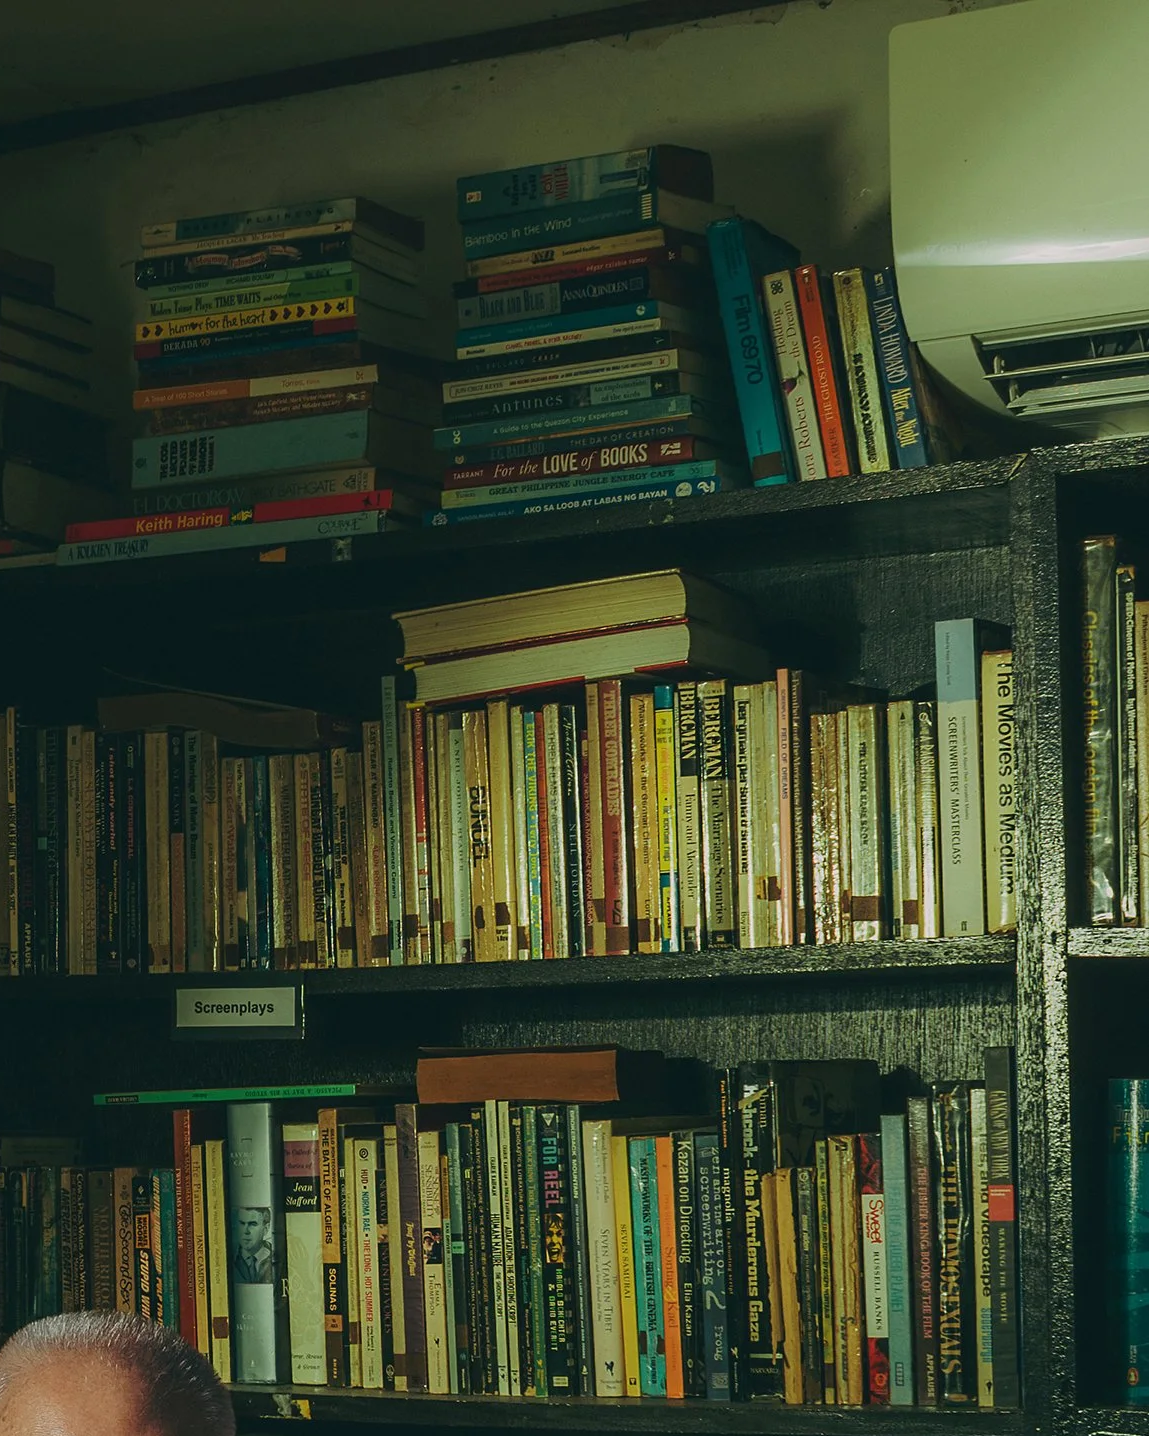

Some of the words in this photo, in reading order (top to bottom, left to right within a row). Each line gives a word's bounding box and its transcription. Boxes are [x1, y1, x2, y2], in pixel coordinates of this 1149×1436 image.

[465, 231, 507, 248] Bamboo
[544, 217, 571, 232] Wind
[206, 319, 220, 330] for
[222, 314, 237, 328] the
[240, 313, 265, 326] heart
[732, 294, 751, 333] Film
[785, 301, 797, 338] Dream
[874, 295, 899, 335] LINDA
[163, 341, 198, 352] DEKADA
[200, 338, 211, 347] 90
[771, 309, 787, 355] Holding
[812, 335, 824, 366] ROAD
[881, 331, 908, 384] HOWARD
[820, 367, 833, 402] GHOST
[891, 387, 913, 412] After
[500, 424, 519, 432] Guide
[531, 421, 543, 429] the
[545, 417, 570, 427] Quezon
[572, 415, 586, 424] City
[588, 408, 628, 422] Experience
[795, 396, 813, 451] Roberts
[895, 419, 918, 448] Night
[453, 470, 484, 480] TARRANT
[494, 464, 514, 478] For
[519, 461, 538, 476] the
[543, 453, 577, 474] LOVE
[581, 450, 597, 470] of
[600, 443, 648, 466] BOOKS
[489, 486, 519, 496] GREAT
[522, 480, 570, 492] PHILIPPINE
[572, 477, 608, 487] JUNGLE
[611, 473, 648, 484] ENERGY
[524, 504, 541, 514] AKO
[543, 503, 555, 512] SA
[556, 500, 581, 510] LOOB
[582, 498, 592, 507] AT
[594, 494, 622, 506] LABAS
[624, 493, 637, 502] NG
[638, 489, 668, 501] BAYAN
[136, 517, 174, 534] Keith
[177, 512, 223, 529] Haring
[680, 690, 696, 760] BERGMAN
[704, 697, 722, 779] BERGMAN
[997, 704, 1015, 777] Movies
[682, 793, 695, 823] Fanny
[711, 784, 724, 808] The
[999, 782, 1013, 807] as
[569, 823, 578, 855] NEIL
[685, 823, 696, 845] and
[708, 812, 724, 864] Marriage
[950, 799, 961, 865] MASTERCLASS
[998, 815, 1015, 894] Medium
[571, 862, 581, 918] JORDAN
[685, 847, 696, 900] Alexander
[714, 867, 726, 924] Scenarios
[194, 1001, 274, 1016] Screenplays
[990, 1090, 1007, 1120] GANGS
[321, 1128, 329, 1147] THE
[542, 1137, 558, 1165] FOR
[991, 1130, 1009, 1155] NEW
[322, 1149, 331, 1186] BATTLE
[677, 1140, 691, 1184] Kazan
[992, 1156, 1010, 1179] YORK
[292, 1182, 313, 1192] Jean
[323, 1188, 331, 1201] OF
[544, 1170, 561, 1208] REEL
[679, 1186, 689, 1202] on
[721, 1167, 735, 1222] magnolia
[744, 1168, 759, 1196] the
[285, 1196, 317, 1206] Stafford
[324, 1202, 333, 1244] ALGIERS
[676, 1206, 694, 1263] Directing
[699, 1166, 715, 1285] screenwriting
[868, 1199, 884, 1244] Sweet
[620, 1224, 629, 1255] SEVEN
[745, 1199, 761, 1297] Murderous
[328, 1268, 338, 1311] SOLINAS
[622, 1256, 631, 1299] SAMURAI
[873, 1251, 882, 1293] RUSSELL
[683, 1282, 693, 1302] Elia
[684, 1304, 694, 1337] Kazan
[749, 1300, 762, 1342] Gaze
[875, 1296, 884, 1331] BANKS
